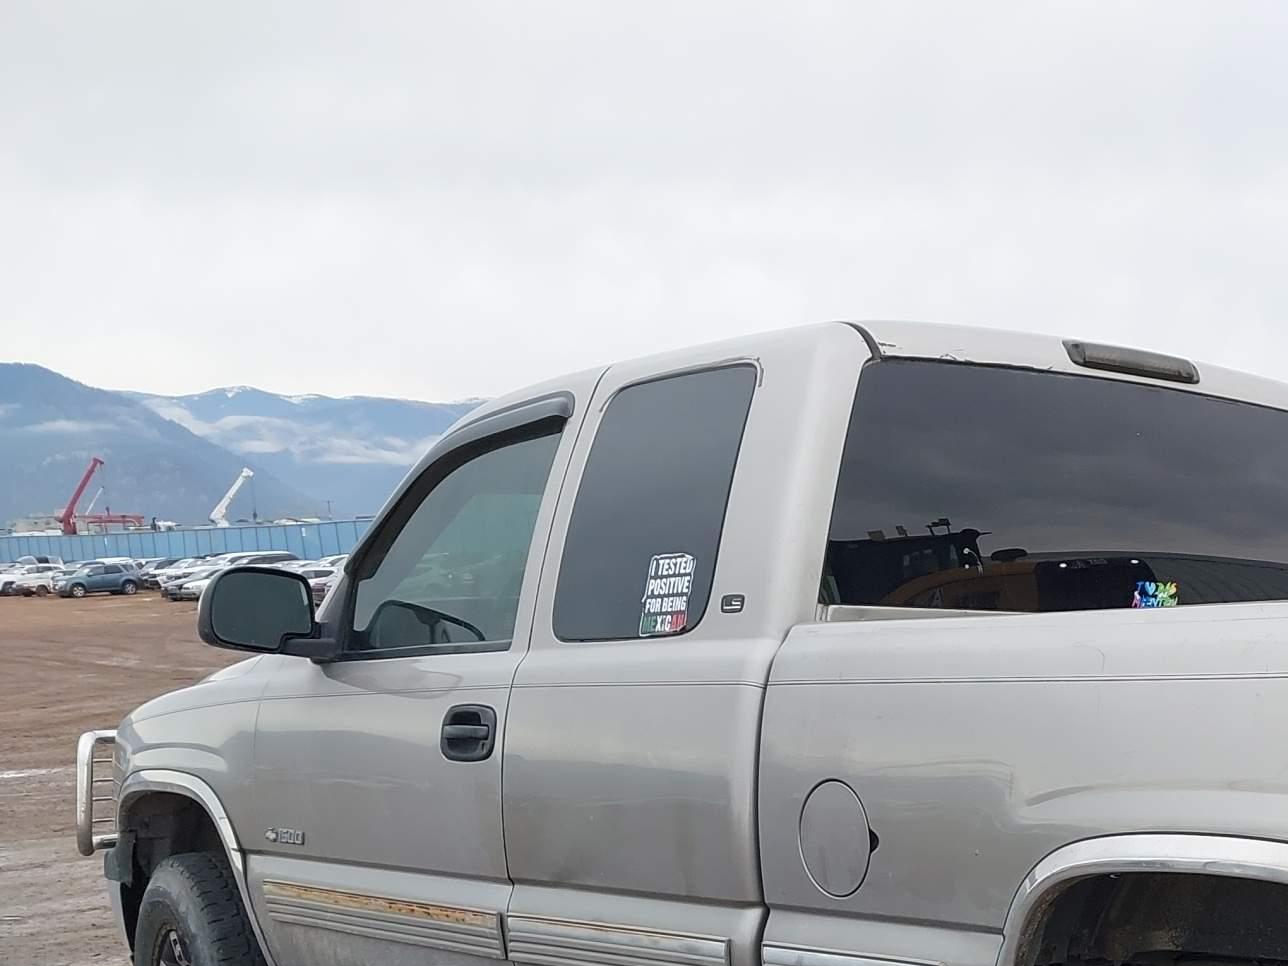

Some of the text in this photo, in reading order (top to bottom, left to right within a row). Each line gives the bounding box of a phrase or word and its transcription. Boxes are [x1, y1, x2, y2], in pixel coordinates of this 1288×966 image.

[651, 557, 694, 576] I TESTED
[648, 576, 691, 596] POSITIVE
[645, 596, 687, 614] FOR BEING
[642, 614, 685, 633] MEXICAN
